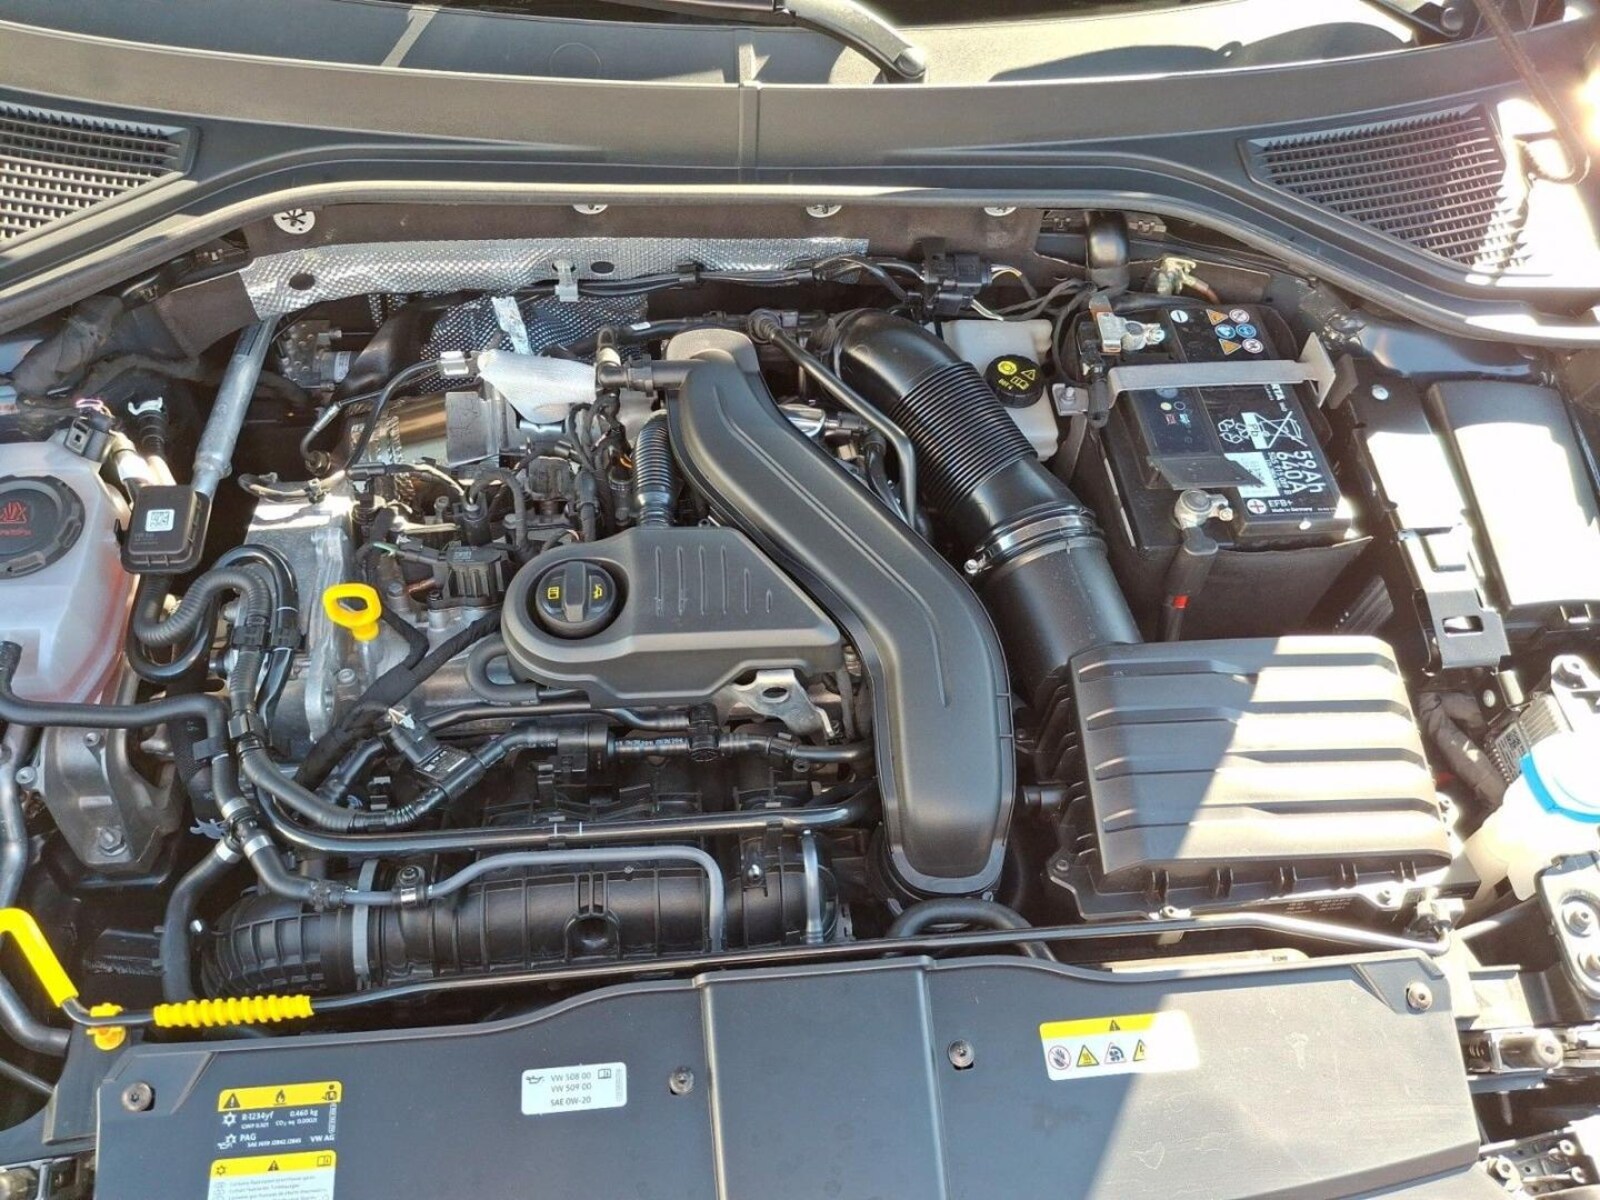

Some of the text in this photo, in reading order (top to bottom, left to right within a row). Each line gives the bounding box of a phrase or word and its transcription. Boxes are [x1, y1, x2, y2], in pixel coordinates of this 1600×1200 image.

[1270, 384, 1285, 400] RTA
[1277, 452, 1307, 493] 640A
[1293, 451, 1326, 493] 59Ah
[1268, 499, 1293, 507] EFB+
[567, 1072, 580, 1080] 508
[566, 1083, 580, 1092] 509
[582, 1082, 592, 1090] 00
[551, 1096, 592, 1106] SAE 0W-20
[309, 1109, 319, 1117] kg
[240, 1133, 257, 1142] PAG
